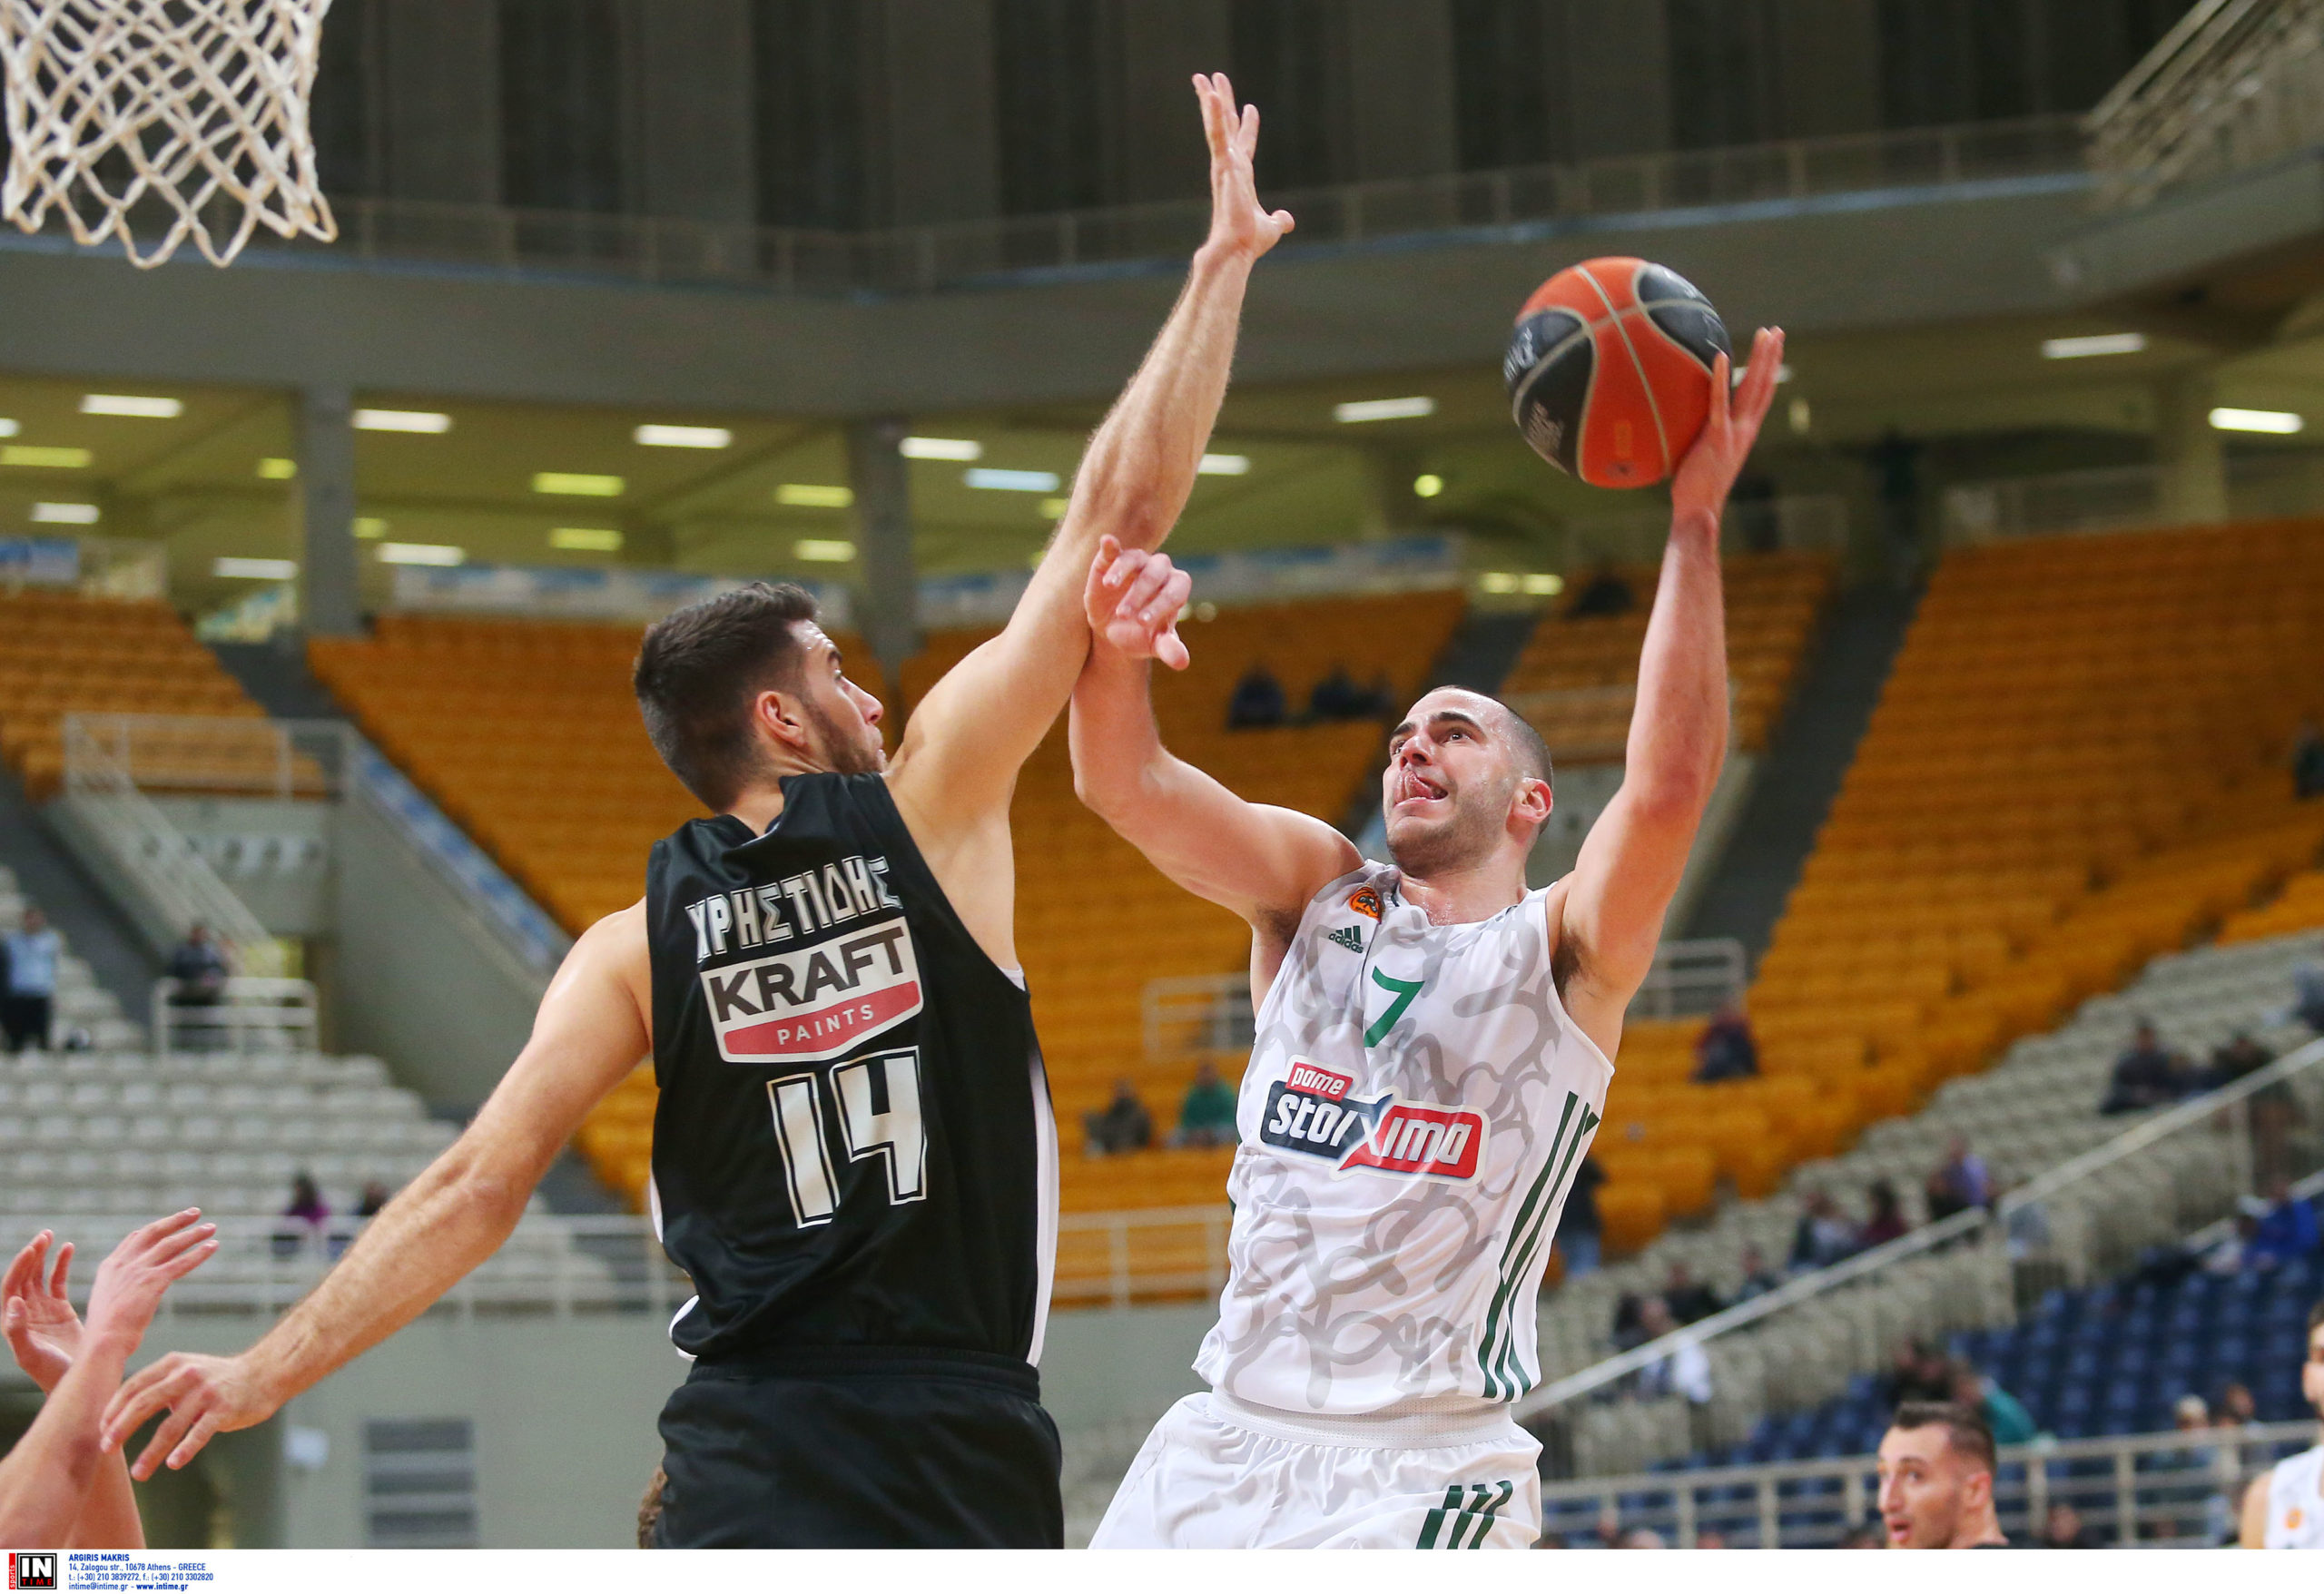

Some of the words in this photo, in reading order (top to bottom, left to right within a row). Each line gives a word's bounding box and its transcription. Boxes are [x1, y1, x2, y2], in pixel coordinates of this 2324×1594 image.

[1328, 932, 1364, 954] adidas
[708, 926, 904, 1023] KRAFT
[776, 1004, 875, 1046] PAINTS
[1364, 965, 1425, 1048] 7
[1291, 1066, 1346, 1096] pame
[766, 1046, 927, 1229] 14
